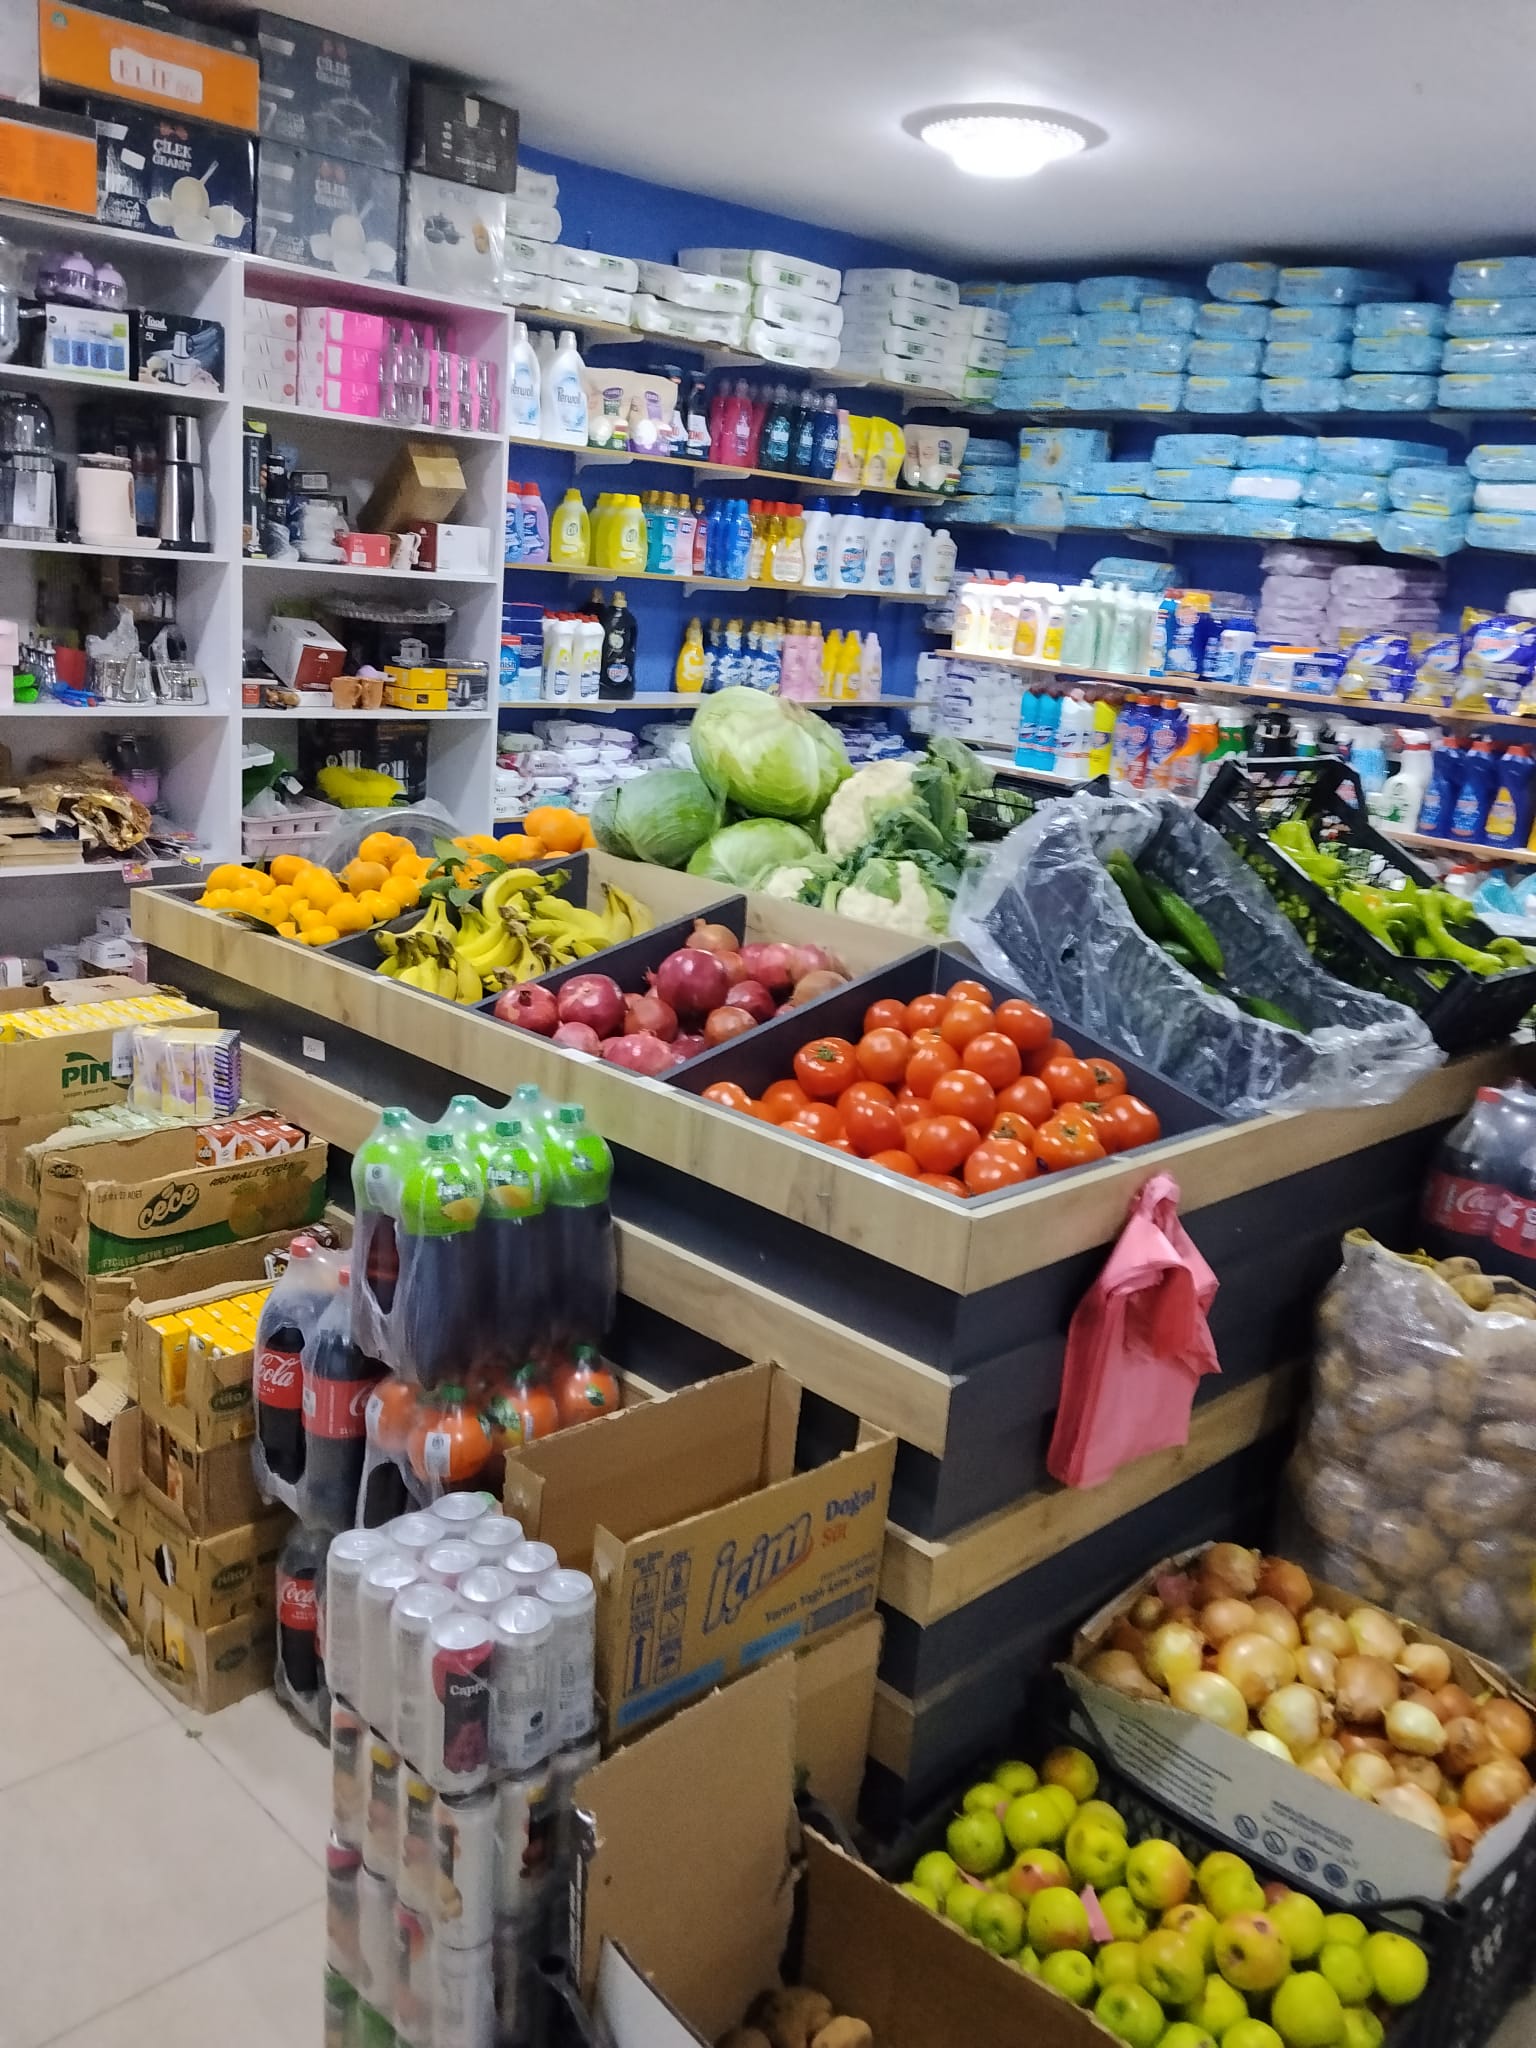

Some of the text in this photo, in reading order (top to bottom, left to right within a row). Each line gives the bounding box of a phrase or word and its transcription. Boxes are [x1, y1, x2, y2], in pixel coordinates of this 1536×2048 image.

[153, 136, 192, 160] ÇİLEK
[152, 152, 193, 173] GRANİT
[556, 386, 581, 406] Perwol
[61, 1062, 113, 1089] PIN
[826, 1482, 877, 1522] Doğal
